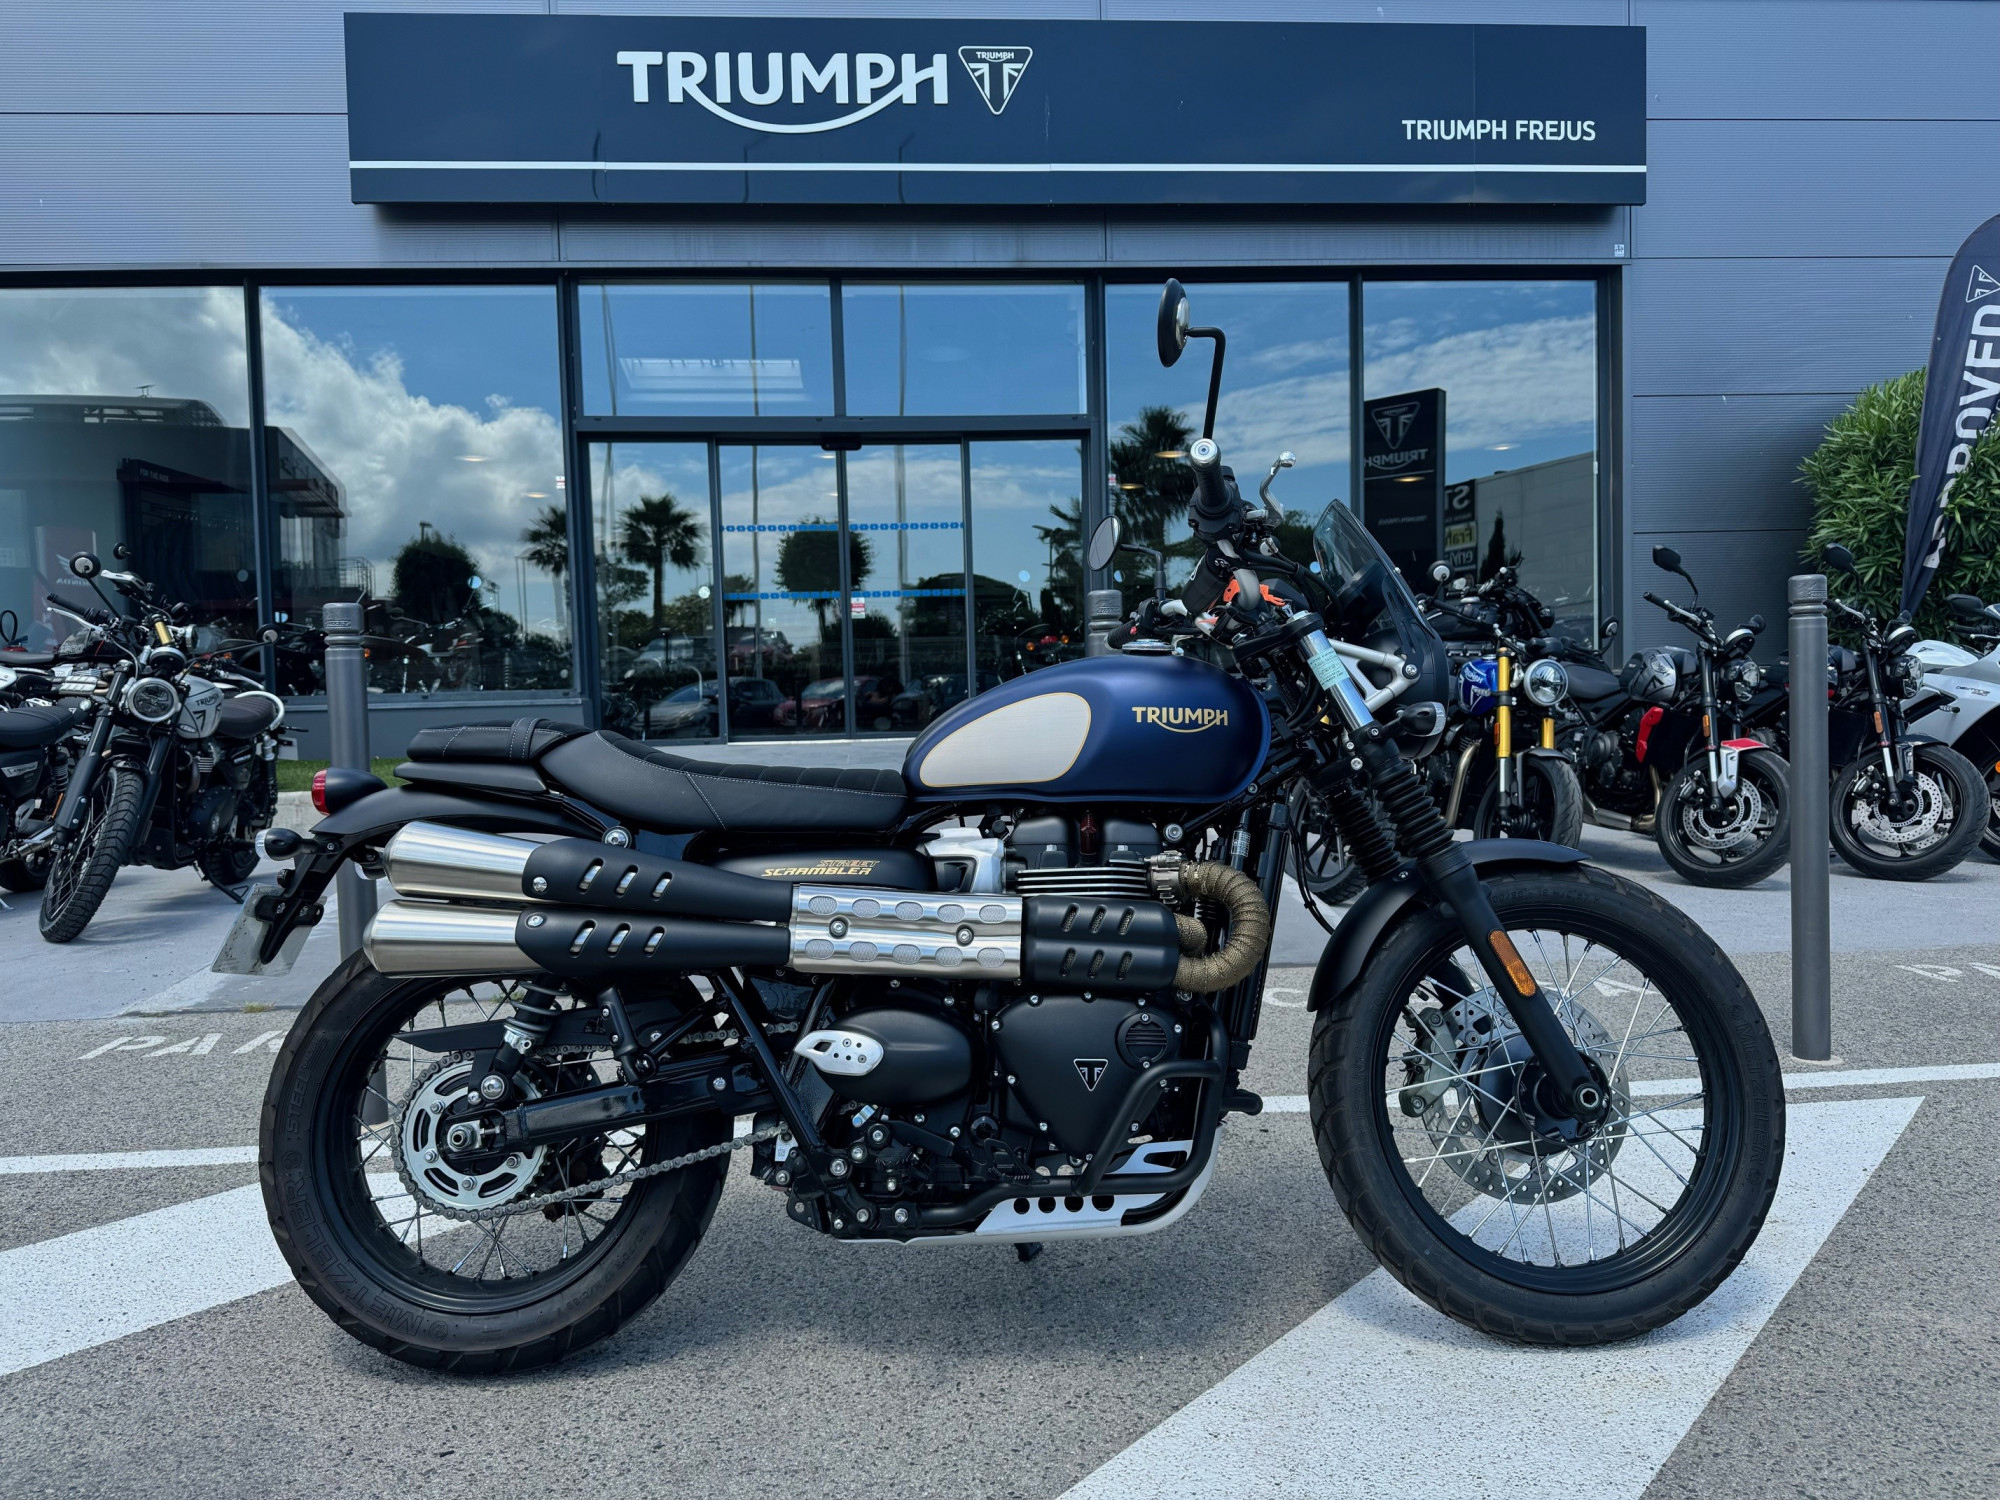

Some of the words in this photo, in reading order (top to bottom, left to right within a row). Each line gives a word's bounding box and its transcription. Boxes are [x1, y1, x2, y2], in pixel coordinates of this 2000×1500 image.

[975, 51, 1015, 62] TRIUMPH
[617, 51, 948, 133] TRIUMPH
[1402, 119, 1507, 140] TRIUMPH
[1516, 120, 1596, 141] FREJUS
[1131, 706, 1229, 733] TRIUMPH
[761, 866, 872, 877] SCRAMBLER
[817, 859, 881, 868] STREET
[287, 1067, 312, 1134] STEEL
[1736, 1020, 1770, 1167] METZELER
[284, 1176, 425, 1337] METZELER
